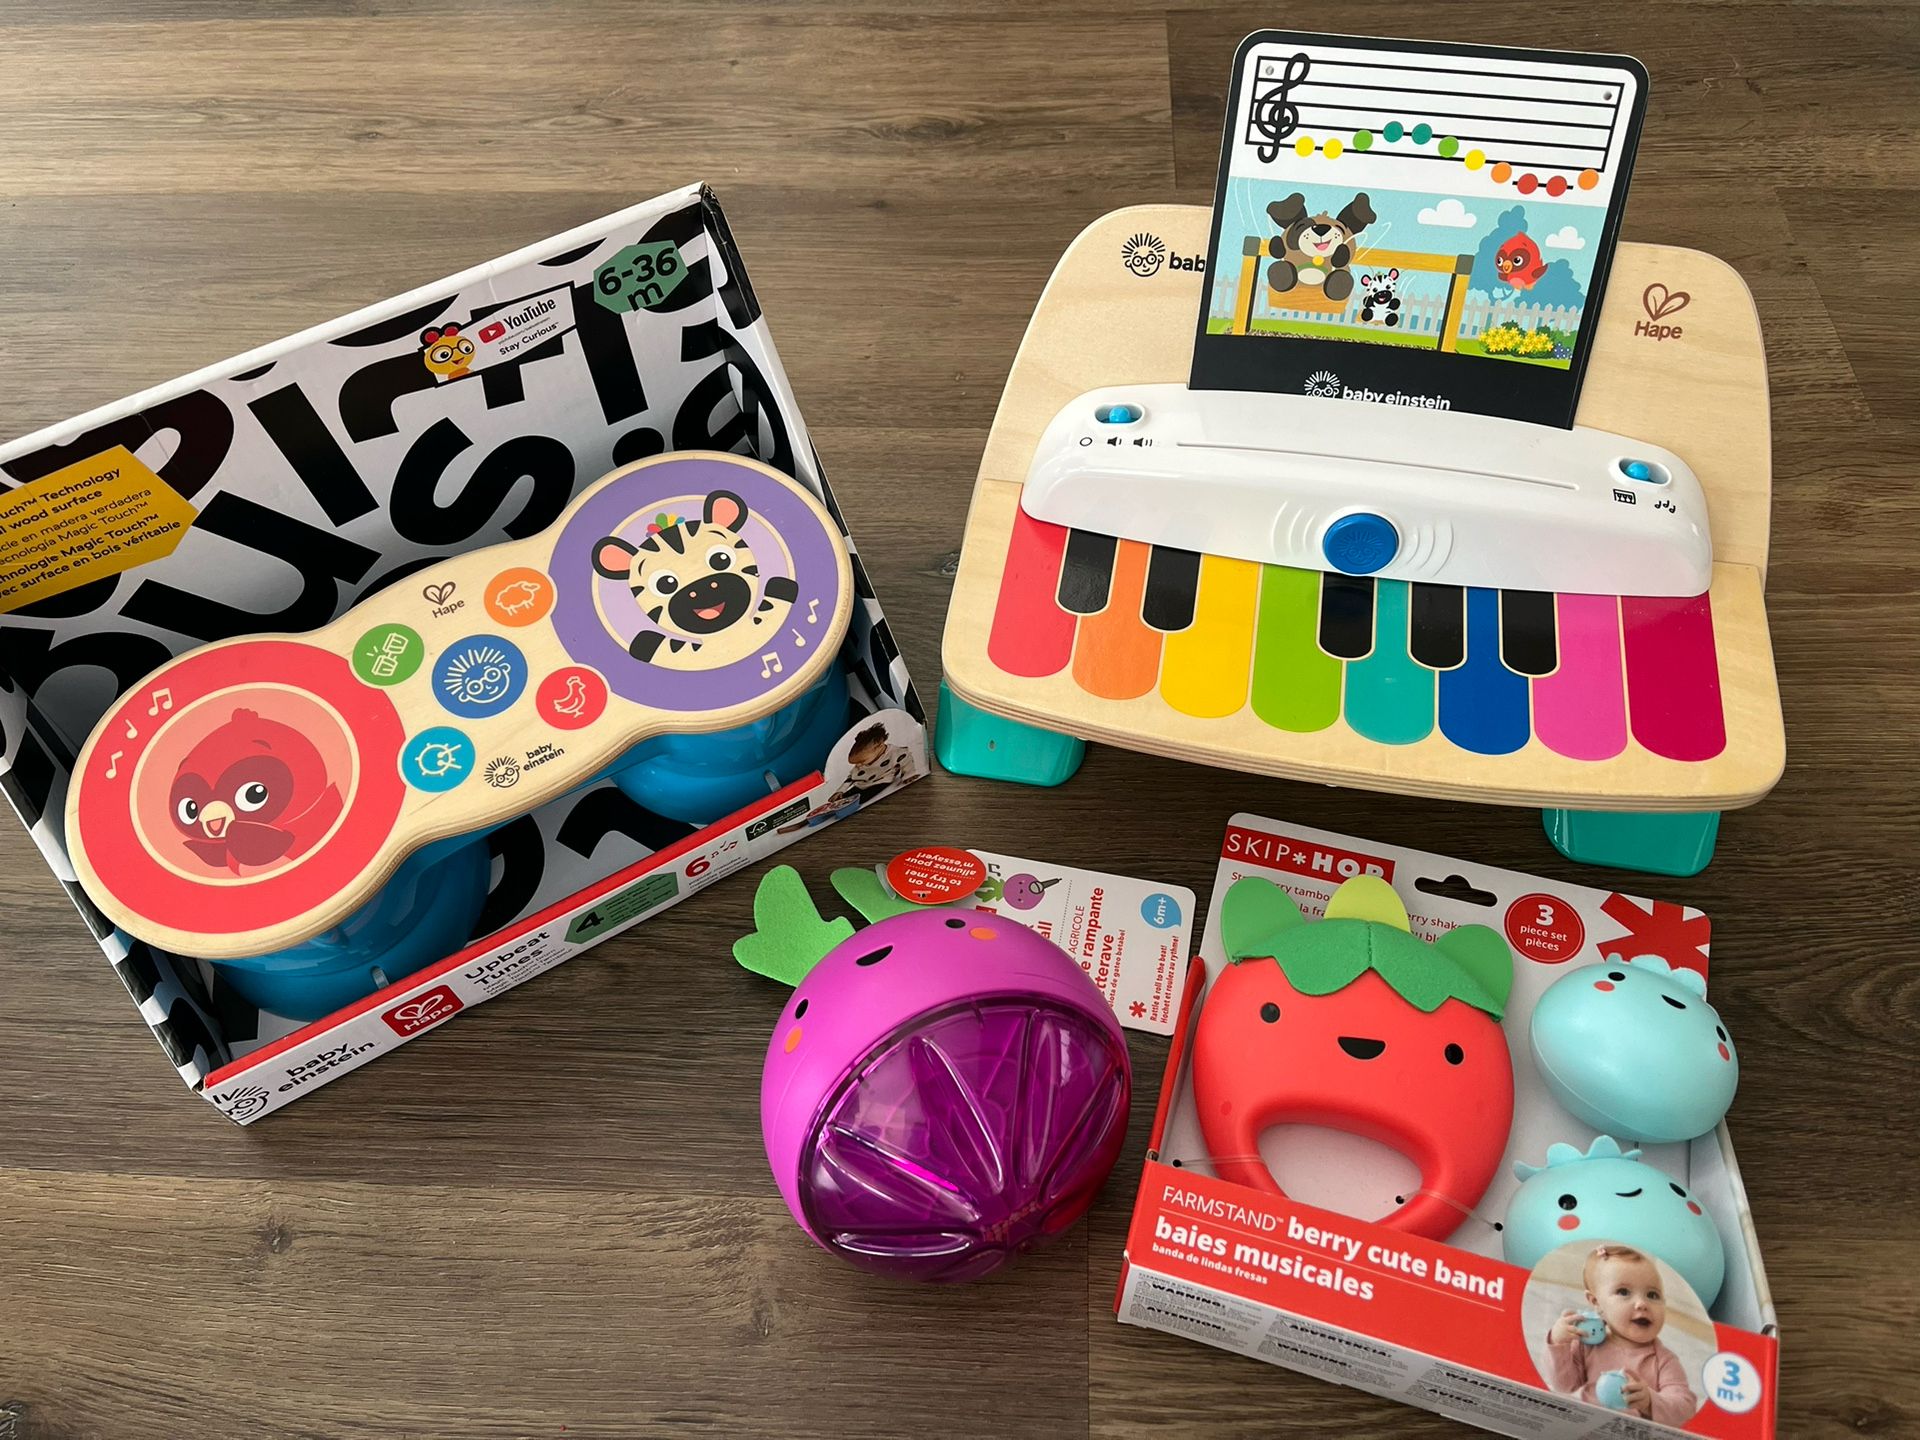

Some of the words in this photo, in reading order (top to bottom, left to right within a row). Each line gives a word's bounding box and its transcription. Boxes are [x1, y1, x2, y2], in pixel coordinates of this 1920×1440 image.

[598, 248, 677, 295] 6-36
[1169, 252, 1206, 272] bab
[627, 282, 664, 312] m
[503, 299, 556, 330] YouTube
[1634, 320, 1683, 342] Hape
[499, 342, 520, 355] Stay
[1342, 386, 1384, 403] baby
[1385, 391, 1451, 411] einstein
[0, 497, 38, 519] uch™
[39, 468, 120, 502] Technology
[8, 509, 49, 530] wood
[51, 490, 103, 514] surface
[21, 532, 38, 543] en
[40, 513, 88, 536] madera
[90, 489, 152, 516] verdadera
[58, 522, 99, 542] Magic
[0, 555, 59, 583] hnologie
[60, 537, 105, 558] Magic
[20, 565, 70, 589] surface
[73, 557, 91, 568] en
[90, 544, 122, 560] bois
[123, 521, 181, 547] véritable
[432, 599, 465, 619] Hape
[523, 747, 565, 771] einstein
[526, 743, 553, 759] baby
[685, 855, 711, 878] 6
[904, 857, 933, 867] pour
[933, 863, 977, 877] allumez
[905, 869, 929, 879] me!
[908, 877, 924, 886] on
[929, 873, 947, 884] try
[949, 878, 962, 886] to
[926, 881, 950, 892] turn
[1295, 888, 1332, 902] tambo
[576, 911, 604, 934] 4
[1082, 887, 1104, 957] rampante
[1154, 897, 1167, 925] 6m+
[1535, 904, 1554, 926] 3
[1037, 921, 1052, 938] all
[1068, 905, 1085, 954] AGRICOLE
[1431, 918, 1461, 929] shak
[1520, 924, 1549, 938] piece
[1550, 930, 1568, 942] set
[464, 931, 550, 979] Upbeat
[1525, 937, 1559, 952] pièces
[1095, 934, 1115, 989] tterave
[1157, 962, 1165, 973] the
[1154, 982, 1163, 994] roll
[1156, 974, 1163, 982] to
[1160, 1000, 1170, 1024] Hochet
[1166, 971, 1174, 992] roulez
[403, 1004, 453, 1031] Hape
[1150, 1001, 1160, 1021] Rattle
[278, 1041, 375, 1093] einstein
[286, 1043, 348, 1077] baby
[1152, 1242, 1184, 1260] banda
[1186, 1253, 1199, 1264] de
[1201, 1257, 1233, 1275] lindas
[1234, 1266, 1268, 1285] fresas
[1155, 1215, 1228, 1256] baies
[1234, 1243, 1374, 1300] musicales
[1288, 1216, 1363, 1262] berry
[1367, 1244, 1428, 1277] cute
[1434, 1259, 1504, 1300] band
[1152, 1283, 1226, 1309] WARNING:
[1147, 1306, 1226, 1332] ATTENTION:
[1290, 1324, 1393, 1358] ADVERTENCIA:
[1722, 1360, 1741, 1388] 3
[1717, 1387, 1745, 1402] m+
